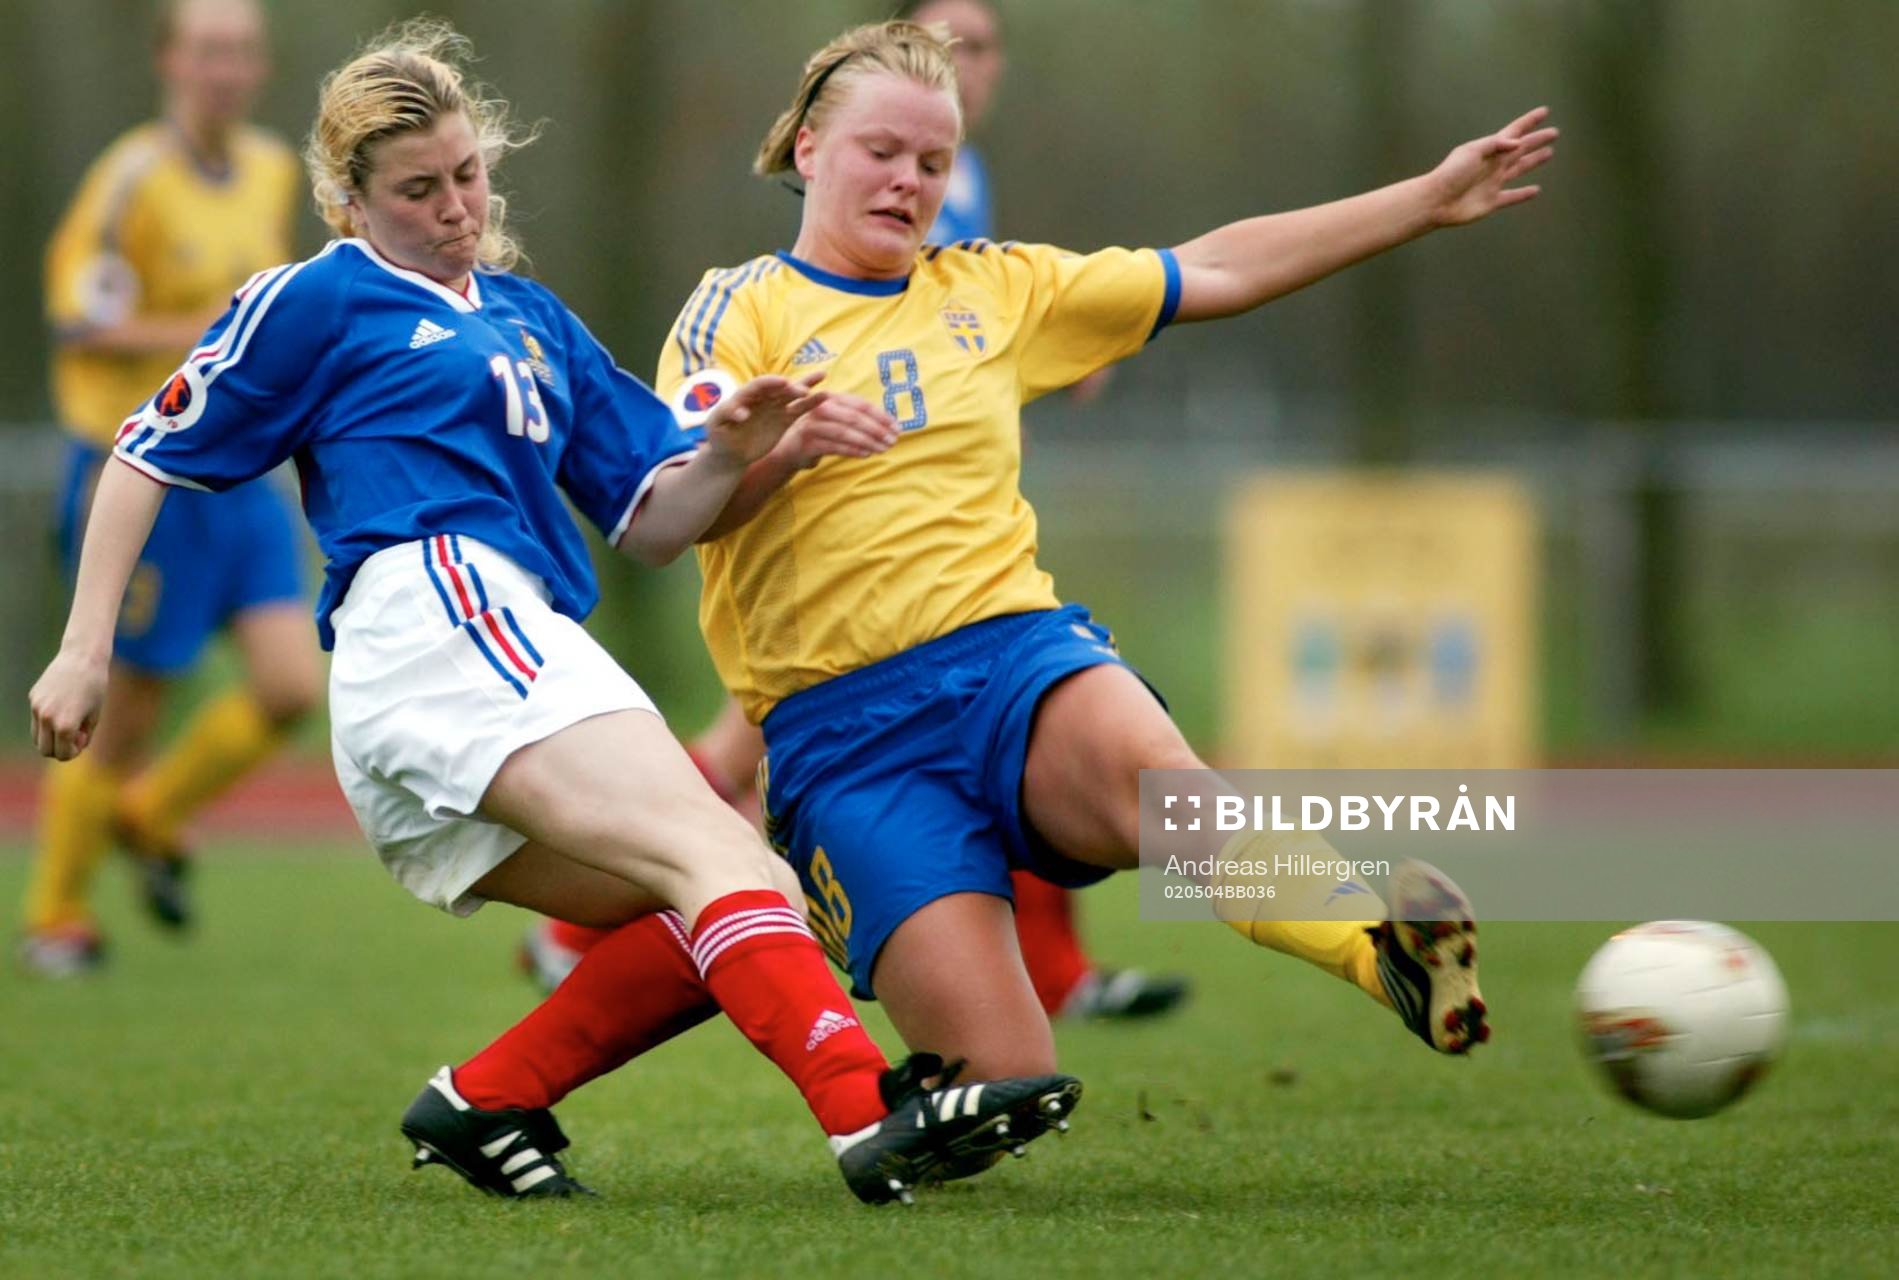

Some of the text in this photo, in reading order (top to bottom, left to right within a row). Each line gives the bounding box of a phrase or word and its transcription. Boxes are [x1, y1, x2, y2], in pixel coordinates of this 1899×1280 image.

[490, 354, 550, 443] 13
[877, 348, 928, 432] 8
[810, 845, 853, 937] 8
